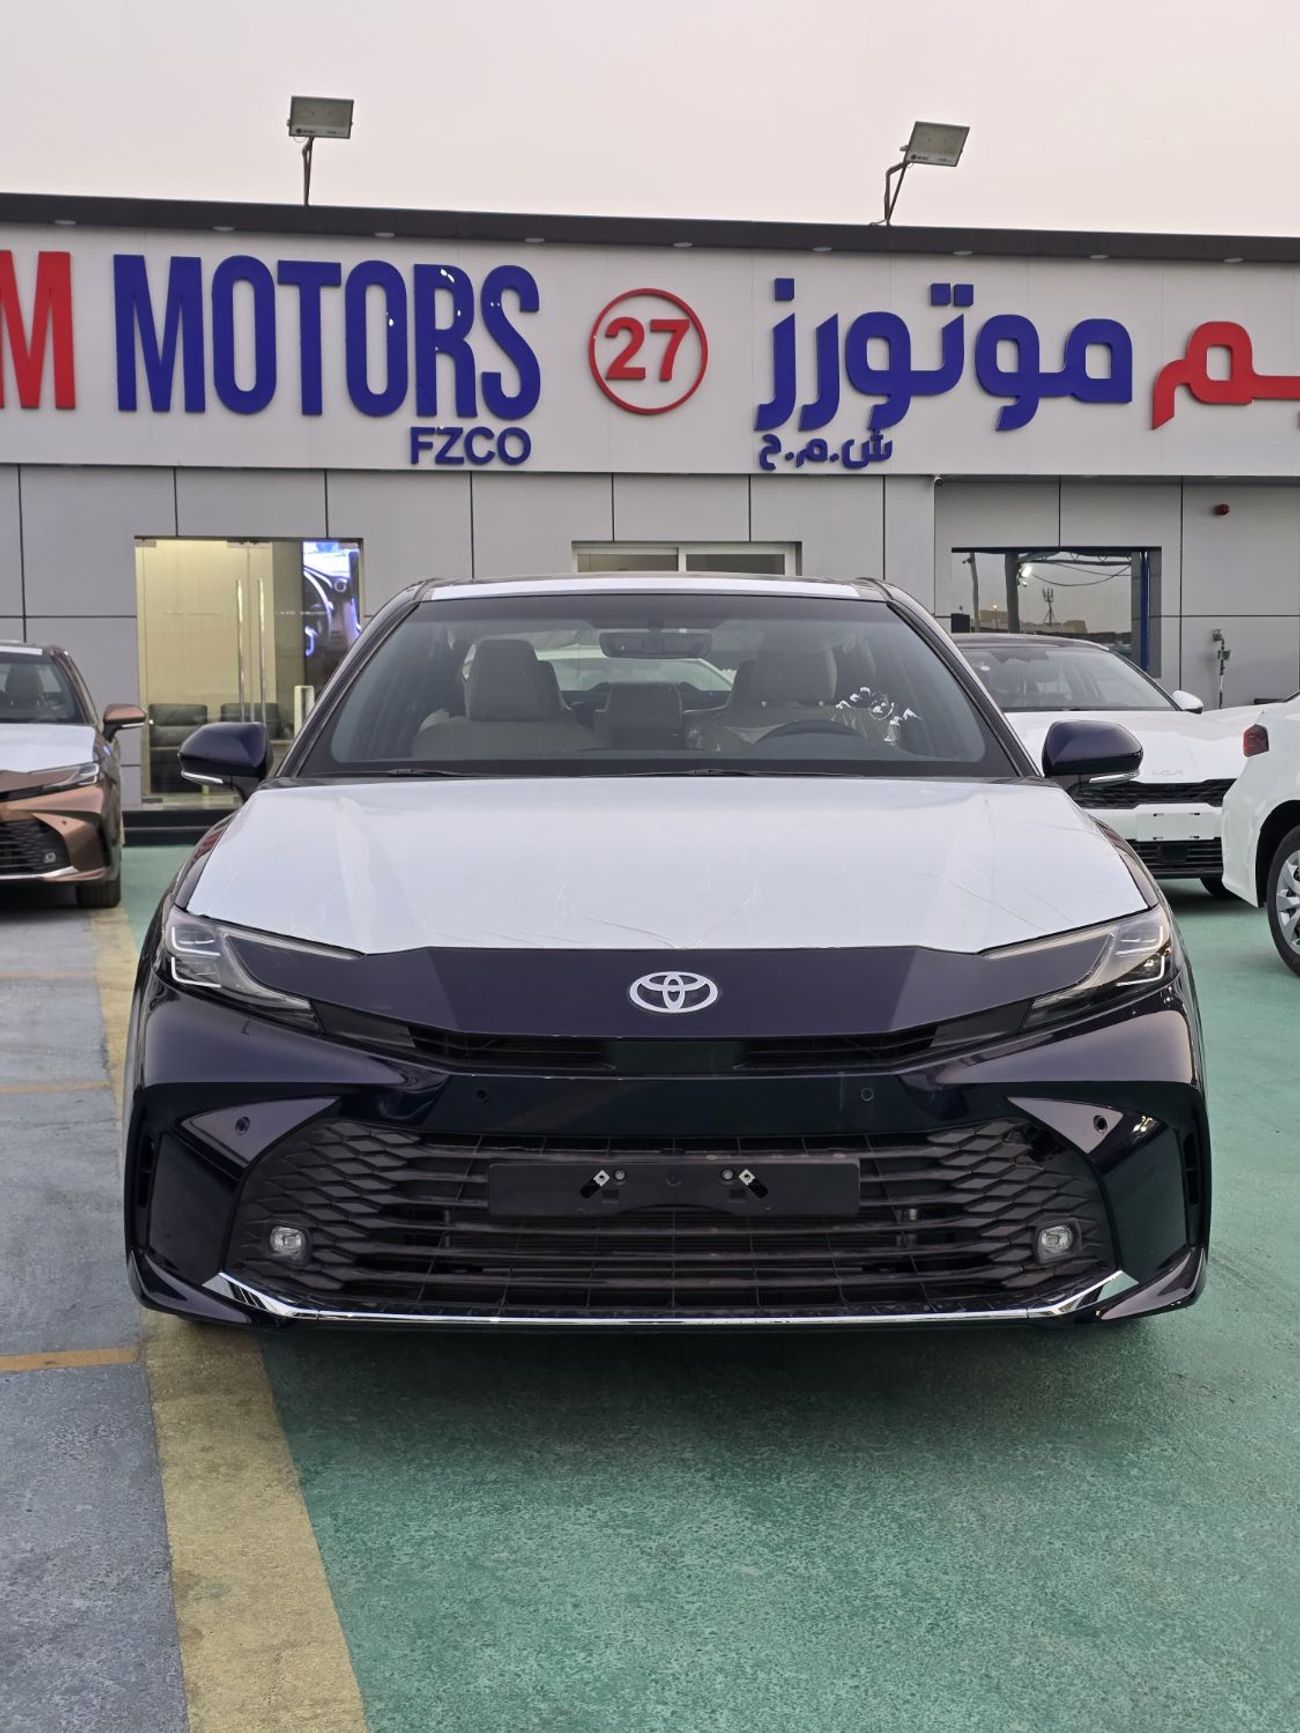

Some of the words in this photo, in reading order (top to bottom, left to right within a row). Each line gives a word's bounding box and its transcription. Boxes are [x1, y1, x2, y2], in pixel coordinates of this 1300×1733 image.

[114, 255, 540, 420] MOTORS
[605, 317, 690, 382] 27
[756, 279, 1132, 431] موتورز
[411, 427, 531, 464] FZCO
